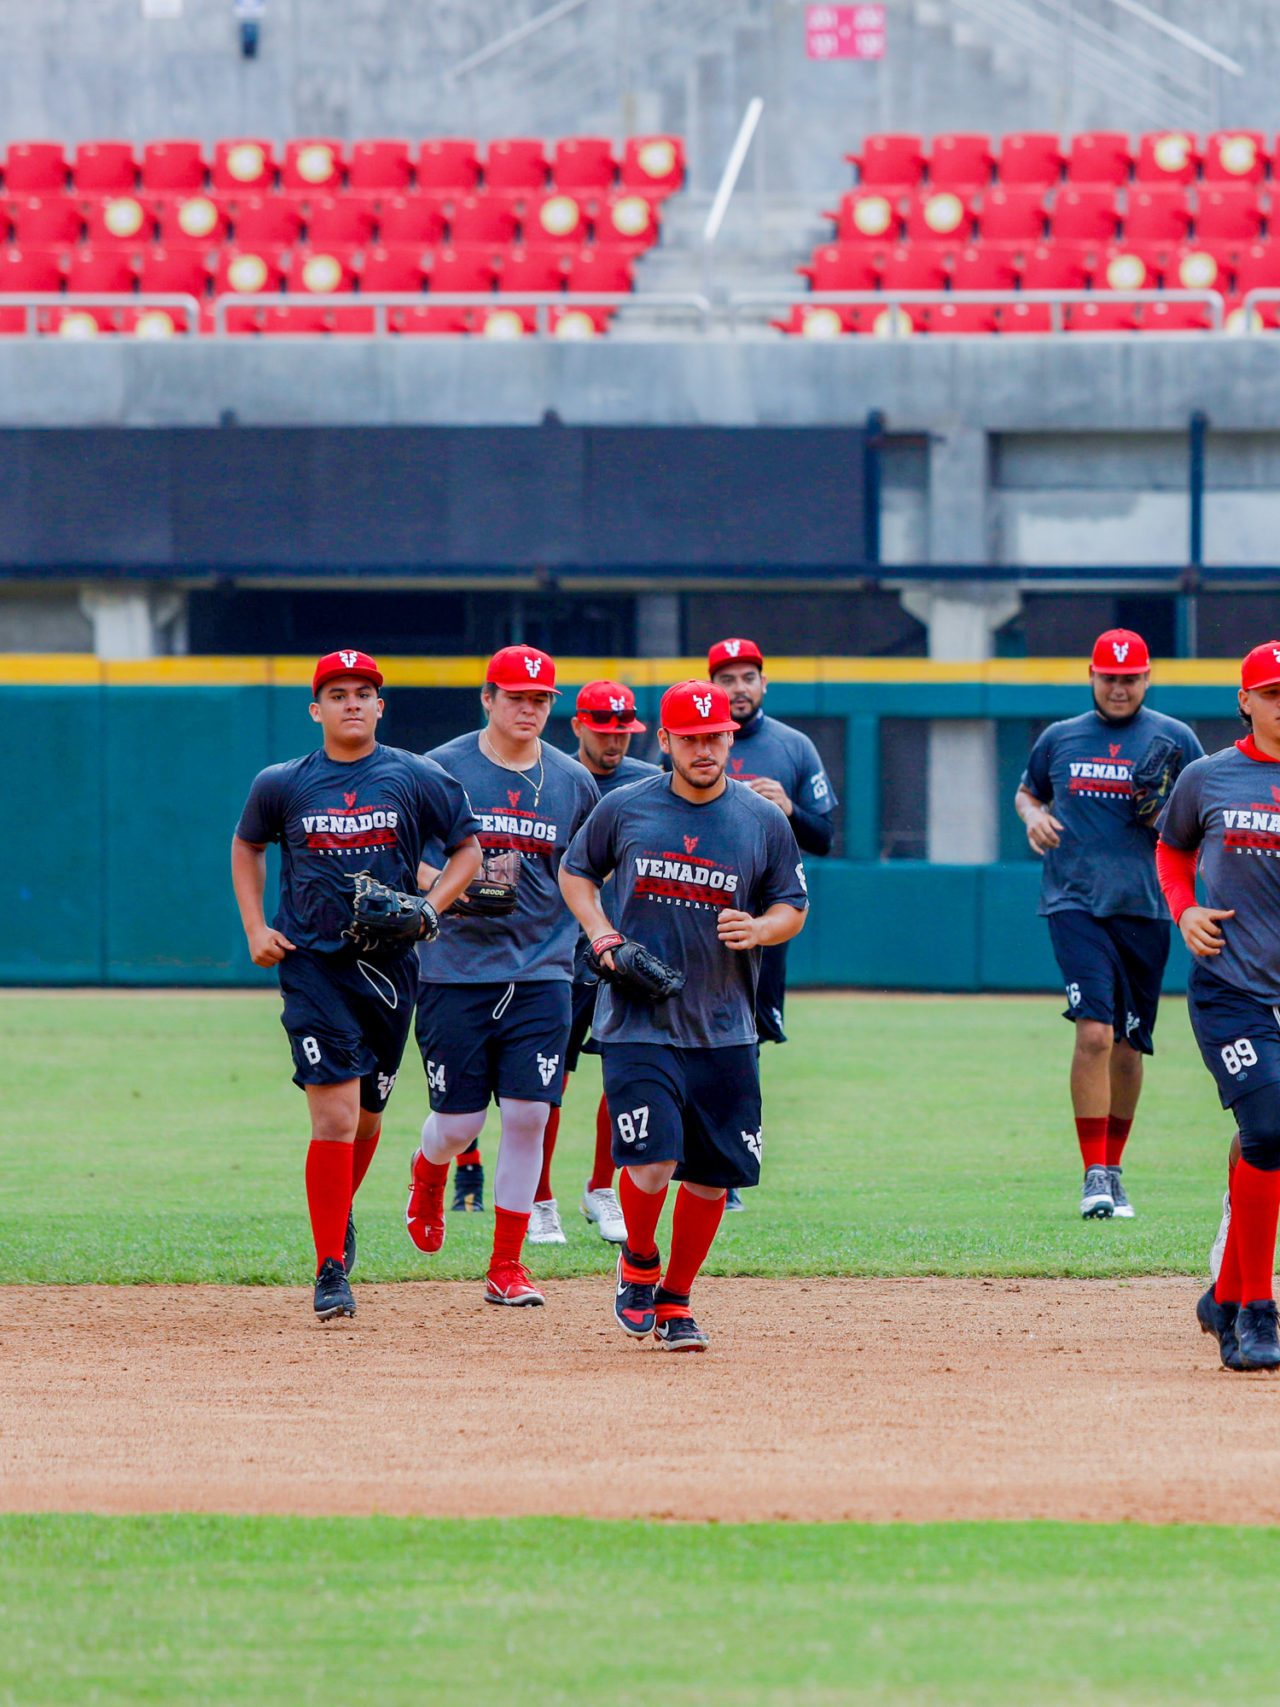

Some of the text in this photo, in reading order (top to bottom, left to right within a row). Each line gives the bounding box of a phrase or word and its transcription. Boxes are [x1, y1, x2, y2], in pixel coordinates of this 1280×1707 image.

[302, 811, 398, 833] VENADOS
[473, 814, 557, 841] ENADOS
[319, 844, 386, 856] BASEBALL
[635, 858, 739, 893] VENADOS
[479, 888, 505, 896] A2000
[302, 1036, 322, 1066] 8
[1221, 1038, 1258, 1075] 89
[427, 1060, 446, 1093] 54
[617, 1105, 650, 1144] 87
